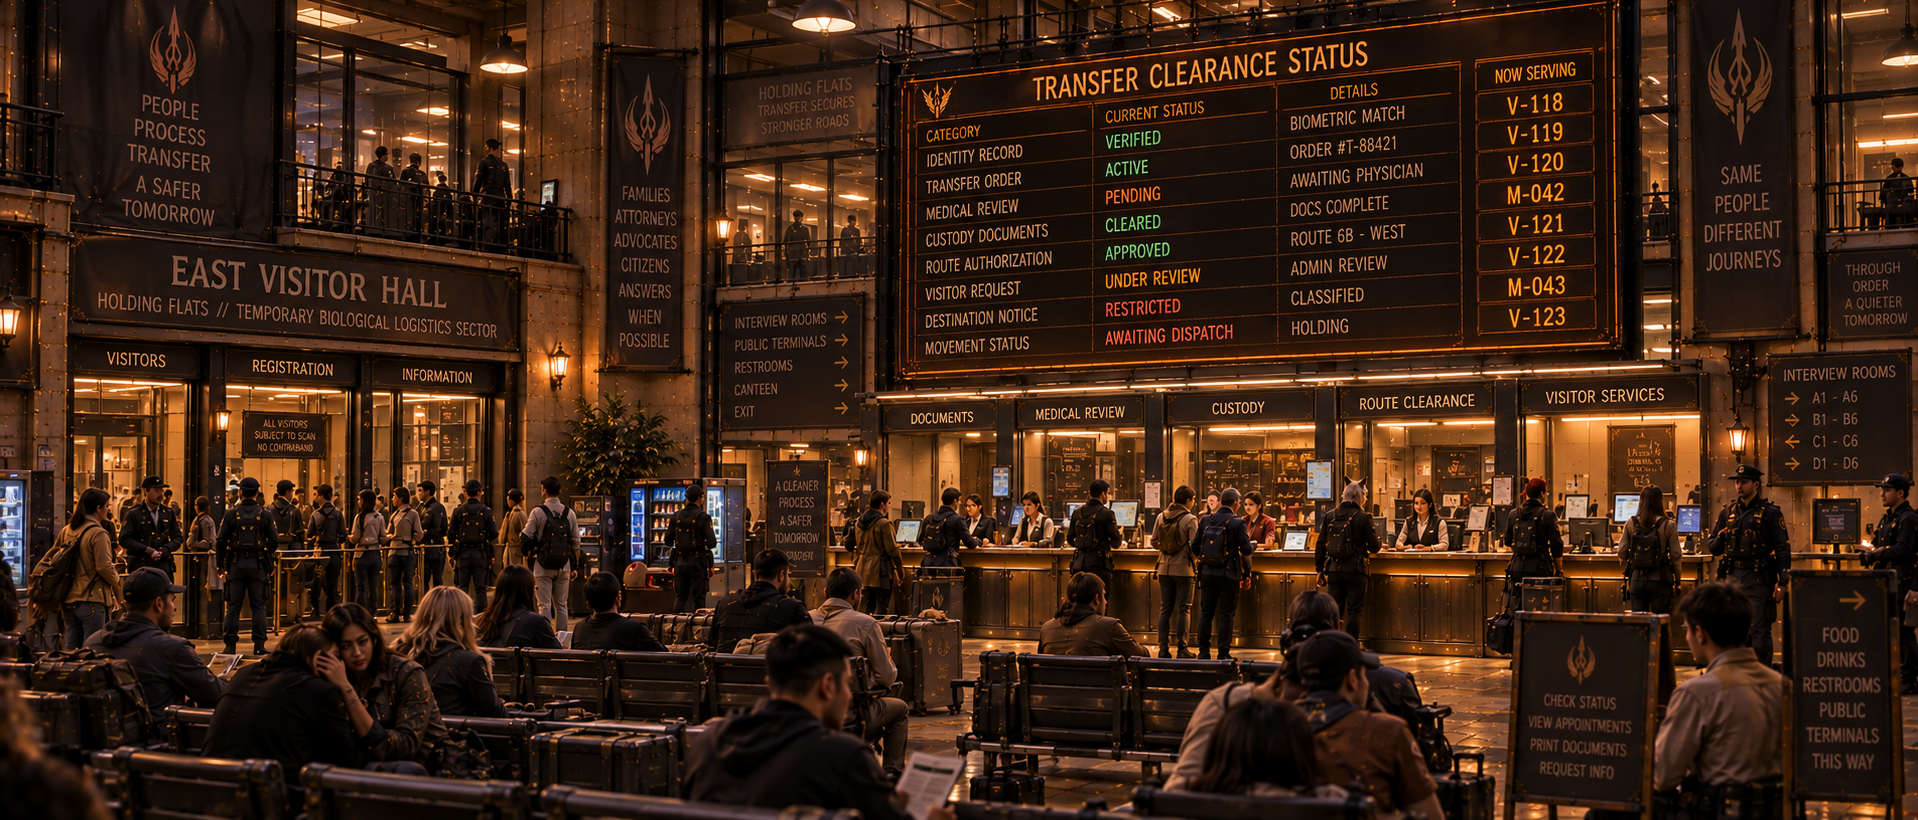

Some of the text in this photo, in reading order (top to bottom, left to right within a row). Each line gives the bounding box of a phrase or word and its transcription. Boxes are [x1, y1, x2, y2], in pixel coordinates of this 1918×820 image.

[1033, 41, 1368, 101] TRANSFER CLEARANCE STATUS
[1496, 62, 1576, 83] NOW SERVING
[759, 77, 852, 100] HOLDING FLATS
[1331, 83, 1378, 100] DETAILS
[143, 95, 199, 120] PEOPLE
[758, 96, 855, 117] TRANSFER SECURES
[1507, 92, 1563, 115] V-118
[1106, 101, 1204, 124] CURRENT STATUS
[1291, 105, 1404, 130] BIOMETRIC MATCH
[135, 119, 205, 146] PROCESS
[761, 114, 849, 134] STRONGER ROADS
[927, 125, 982, 142] CATEGORY
[1106, 130, 1161, 149] VERIFIED
[1508, 122, 1562, 144] V-119
[927, 144, 1022, 167] IDENTITY RECORD
[1290, 136, 1395, 159] ORDER #T-88421
[127, 143, 210, 173] TRANSFER
[1508, 152, 1563, 174] V-120
[1106, 160, 1148, 177] ACTIVE
[1290, 163, 1423, 188] AWAITING PHYSICIAN
[1721, 164, 1761, 184] SAME
[136, 175, 200, 200] A SAFER
[926, 172, 1021, 193] TRANSFER ORDER
[623, 186, 670, 202] FAMILIES
[1106, 186, 1160, 204] PENDING
[1508, 183, 1564, 204] M-042
[927, 199, 1018, 220] MEDICAL REVIEW
[1291, 196, 1388, 217] DOCS COMPLETE
[1716, 193, 1769, 213] PEOPLE
[122, 199, 214, 226] TOMORROW
[615, 209, 676, 226] ATTORNEYS
[1106, 215, 1160, 232] CLEARED
[1508, 214, 1563, 235] V-121
[1705, 220, 1782, 243] DIFFERENT
[614, 233, 677, 249] ADVOCATES
[926, 224, 1048, 247] CUSTODY DOCUMENTS
[1291, 229, 1332, 246] ROUTE
[1338, 228, 1353, 242] 6B
[1370, 224, 1405, 240] WEST
[1105, 242, 1170, 260] APPROVED
[1509, 244, 1564, 266] V-122
[622, 257, 669, 273] CITIZENS
[926, 251, 1052, 273] ROUTE AUTHORIZATION
[1291, 255, 1387, 276] ADMIN REVIEW
[1706, 249, 1781, 271] JOURNEYS
[1845, 262, 1900, 275] THROUGH
[172, 255, 446, 308] EAST VISITOR HALL
[1106, 268, 1200, 289] UNDER REVIEW
[1509, 275, 1565, 297] M-043
[1853, 279, 1888, 292] ORDER
[619, 283, 671, 299] ANSWERS
[926, 281, 1021, 300] VISITOR REQUEST
[1291, 288, 1364, 305] CLASSIFIED
[1106, 299, 1180, 317] RESTRICTED
[1845, 296, 1902, 310] A QUIETER
[98, 292, 161, 312] HOLDING
[169, 298, 208, 316] FLATS
[236, 304, 314, 323] TEMPORARY
[320, 310, 389, 329] BIOLOGICAL
[395, 317, 451, 334] LOGISTICS
[456, 318, 497, 338] SECTOR
[628, 309, 661, 324] WHEN
[735, 312, 826, 328] INTERVIEW ROOMS
[926, 307, 1037, 328] DESTINATION NOTICE
[1509, 307, 1565, 328] V-123
[1843, 313, 1907, 326] TOMORROW
[1106, 324, 1233, 345] AWAITING DISPATCH
[1292, 318, 1348, 335] HOLDING
[620, 333, 669, 348] POSSIBLE
[735, 335, 826, 351] PUBLIC TERMINALS
[926, 336, 1029, 355] MOVEMENT STATUS
[107, 352, 165, 367] VISITORS
[253, 360, 333, 376] REGISTRATION
[735, 360, 793, 373] RESTROOMS
[403, 368, 472, 383] INFORMATION
[1784, 365, 1896, 381] INTERVIEW ROOMS
[735, 383, 777, 396] CANTEEN
[1546, 388, 1664, 404] VISITOR SERVICES
[1812, 392, 1825, 403] A1
[1843, 390, 1857, 402] A6
[1212, 401, 1264, 414] CUSTODY
[1360, 394, 1475, 410] ROUTE CLEARANCE
[735, 406, 755, 417] EXIT
[911, 411, 973, 424] DOCUMENTS
[1036, 406, 1125, 420] MEDICAL REVIEW
[1813, 414, 1825, 425] B1
[1844, 413, 1858, 425] B6
[278, 420, 307, 428] VISITORS
[255, 431, 284, 439] SUBJECT
[298, 432, 315, 440] SCAN
[1813, 435, 1825, 447] C1
[1843, 435, 1858, 447] C6
[258, 443, 267, 451] NO
[1814, 457, 1825, 469] D1
[1844, 457, 1858, 469] D6
[776, 480, 818, 491] A CLEANER
[780, 515, 811, 526] A SAFER
[774, 533, 819, 543] TOMORROW
[1823, 627, 1859, 643] FOOD
[1818, 652, 1865, 667] DRINKS
[1803, 677, 1881, 693] RESTROOMS
[1544, 694, 1616, 710] CHECK STATUS
[1820, 702, 1865, 718] PUBLIC
[1529, 716, 1631, 734] VIEW APPOINTMENTS
[1806, 727, 1879, 743] TERMINALS
[1531, 738, 1626, 756] PRINT DOCUMENTS
[1812, 753, 1874, 769] THIS WAY
[1540, 761, 1614, 779] REQUEST INFO
